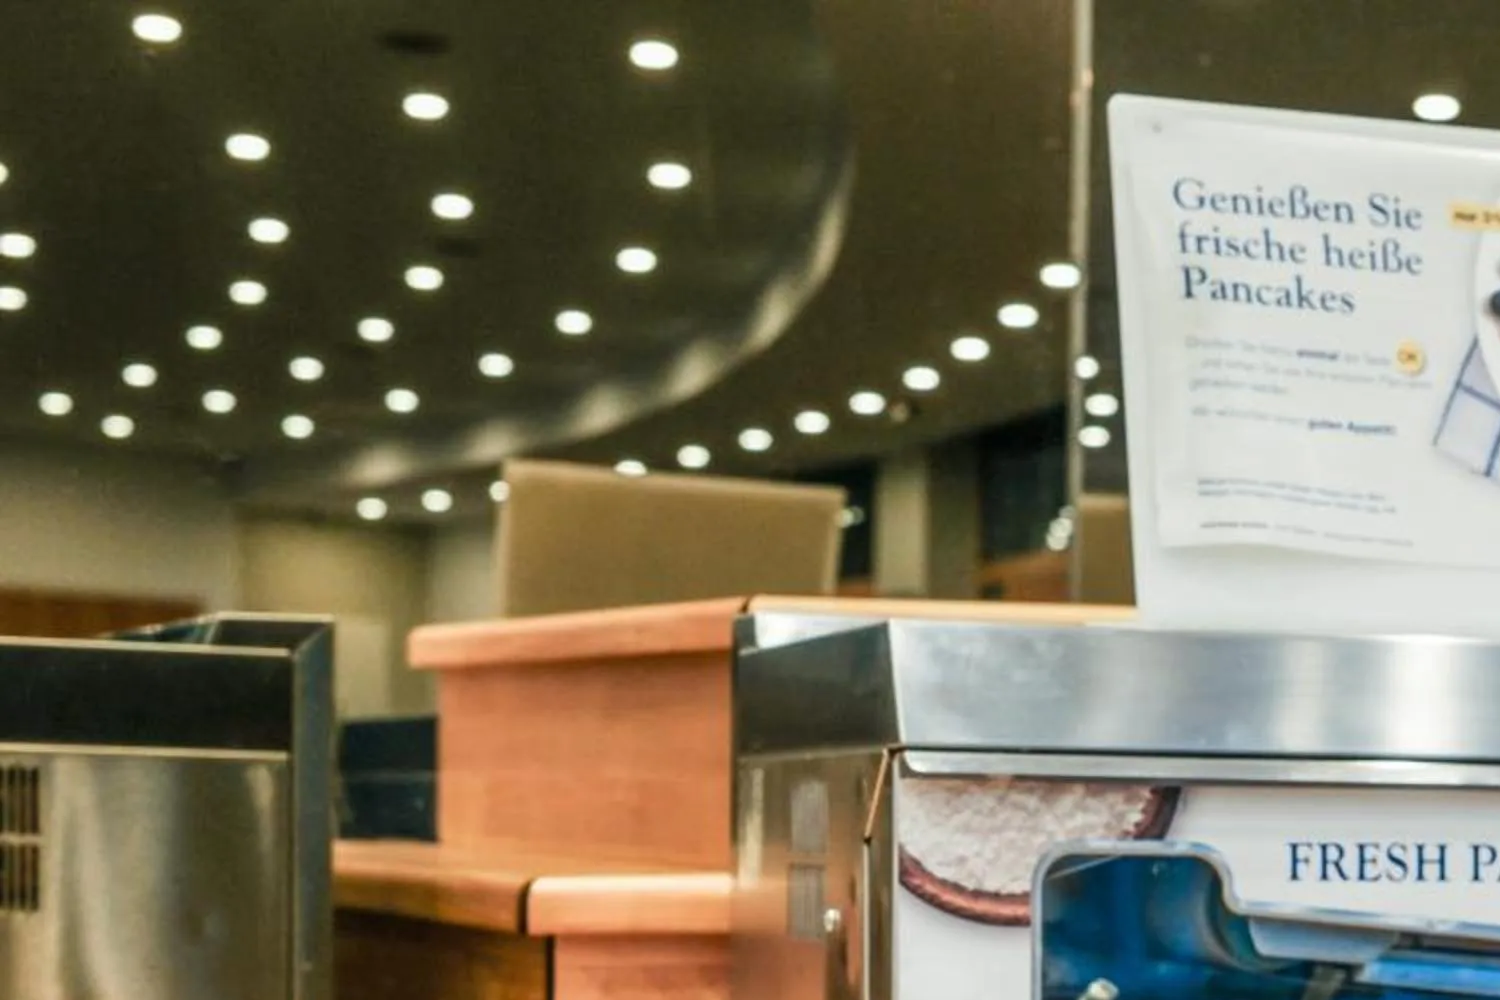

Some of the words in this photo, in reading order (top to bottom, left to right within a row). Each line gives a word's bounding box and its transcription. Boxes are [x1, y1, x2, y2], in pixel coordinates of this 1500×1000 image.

[1172, 177, 1356, 225] Genießen
[1368, 193, 1423, 230] Sie
[1177, 221, 1307, 264] frische
[1322, 233, 1423, 276] heiße
[1181, 265, 1356, 314] Pancakes
[1286, 841, 1450, 884] FRESH
